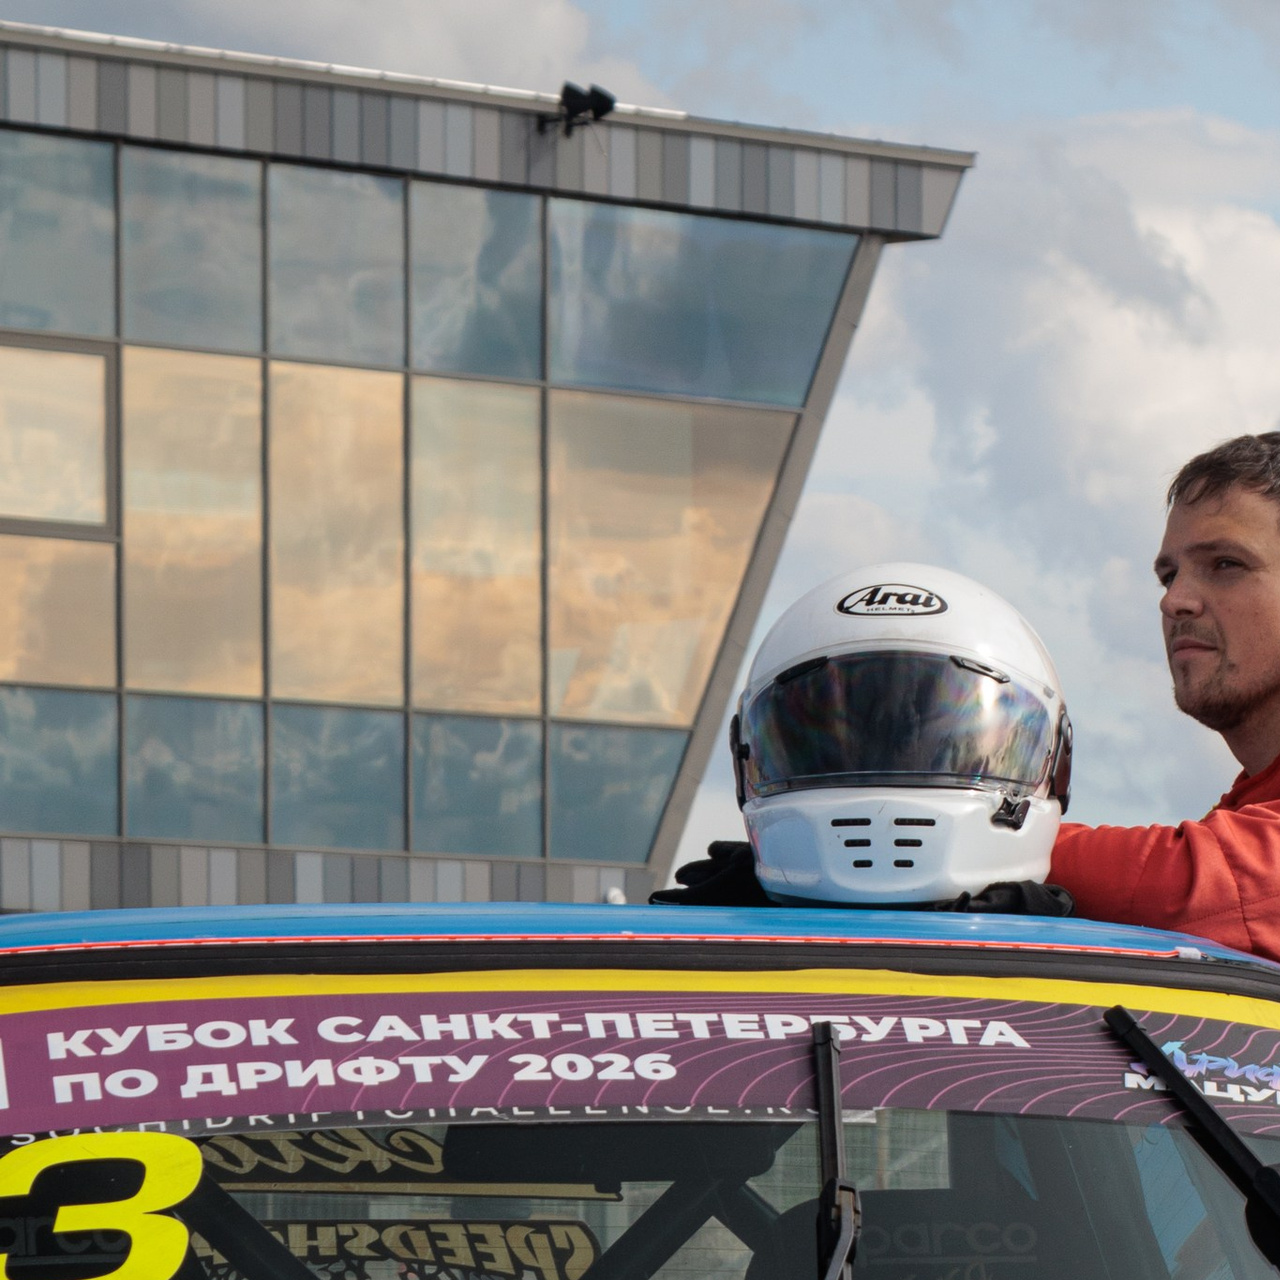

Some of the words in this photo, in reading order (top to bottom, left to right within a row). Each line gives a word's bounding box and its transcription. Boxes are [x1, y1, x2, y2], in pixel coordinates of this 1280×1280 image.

[841, 587, 937, 609] Arai
[47, 1017, 300, 1060] КУБОК
[53, 1068, 159, 1104] ПО
[180, 1054, 489, 1098] ДРИФТУ
[508, 1053, 677, 1081] 2026
[858, 1221, 1038, 1268] parco
